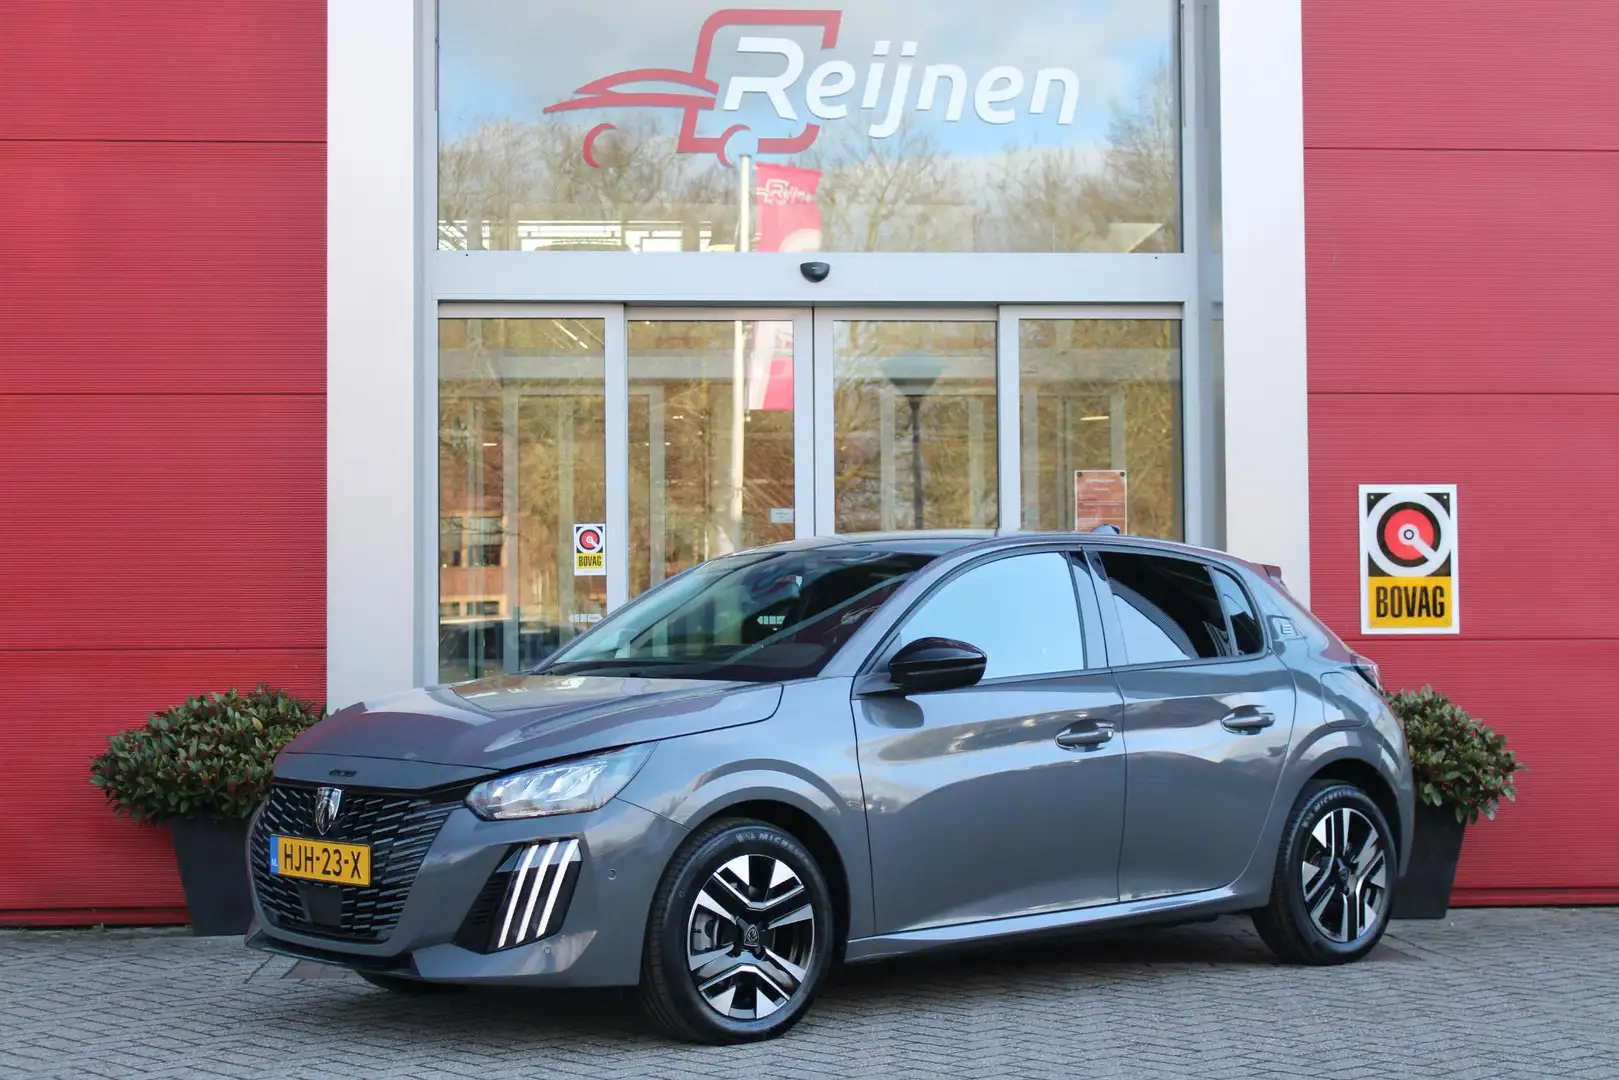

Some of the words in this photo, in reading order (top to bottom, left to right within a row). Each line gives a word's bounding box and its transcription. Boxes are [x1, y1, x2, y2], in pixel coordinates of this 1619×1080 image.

[722, 36, 1081, 139] Reijnen
[578, 555, 602, 567] BOVAG
[1375, 586, 1445, 618] BOVAG
[283, 843, 362, 879] HJH-23-X
